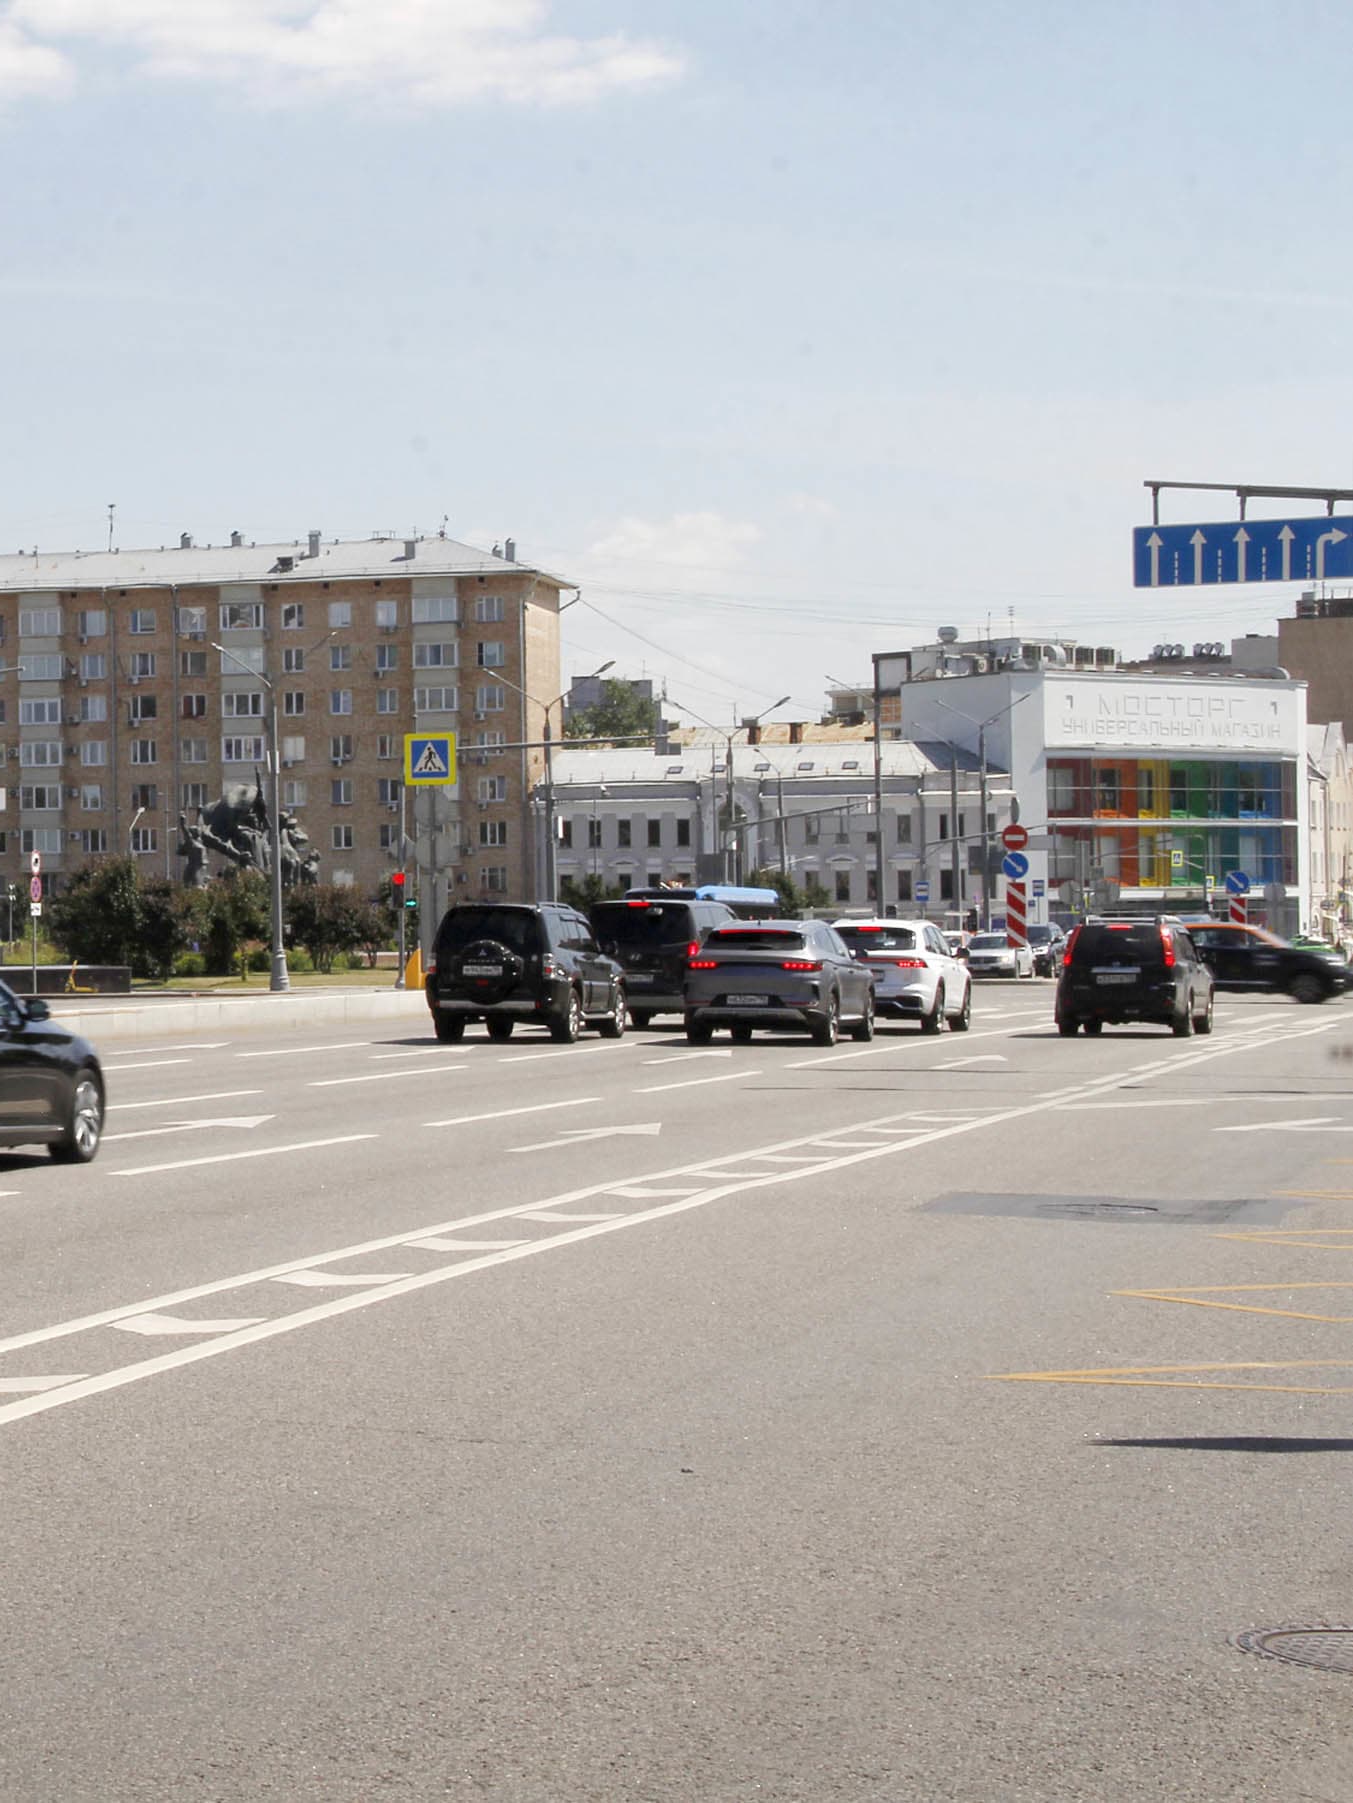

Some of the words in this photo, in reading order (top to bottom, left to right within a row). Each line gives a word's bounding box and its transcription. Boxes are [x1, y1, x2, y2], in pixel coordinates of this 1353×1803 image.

[1098, 695, 1248, 718] МОСТОРГ
[1063, 717, 1205, 737] УНИВЕРСАЛЬНЫЙ
[1211, 721, 1281, 738] МАГАЗИН
